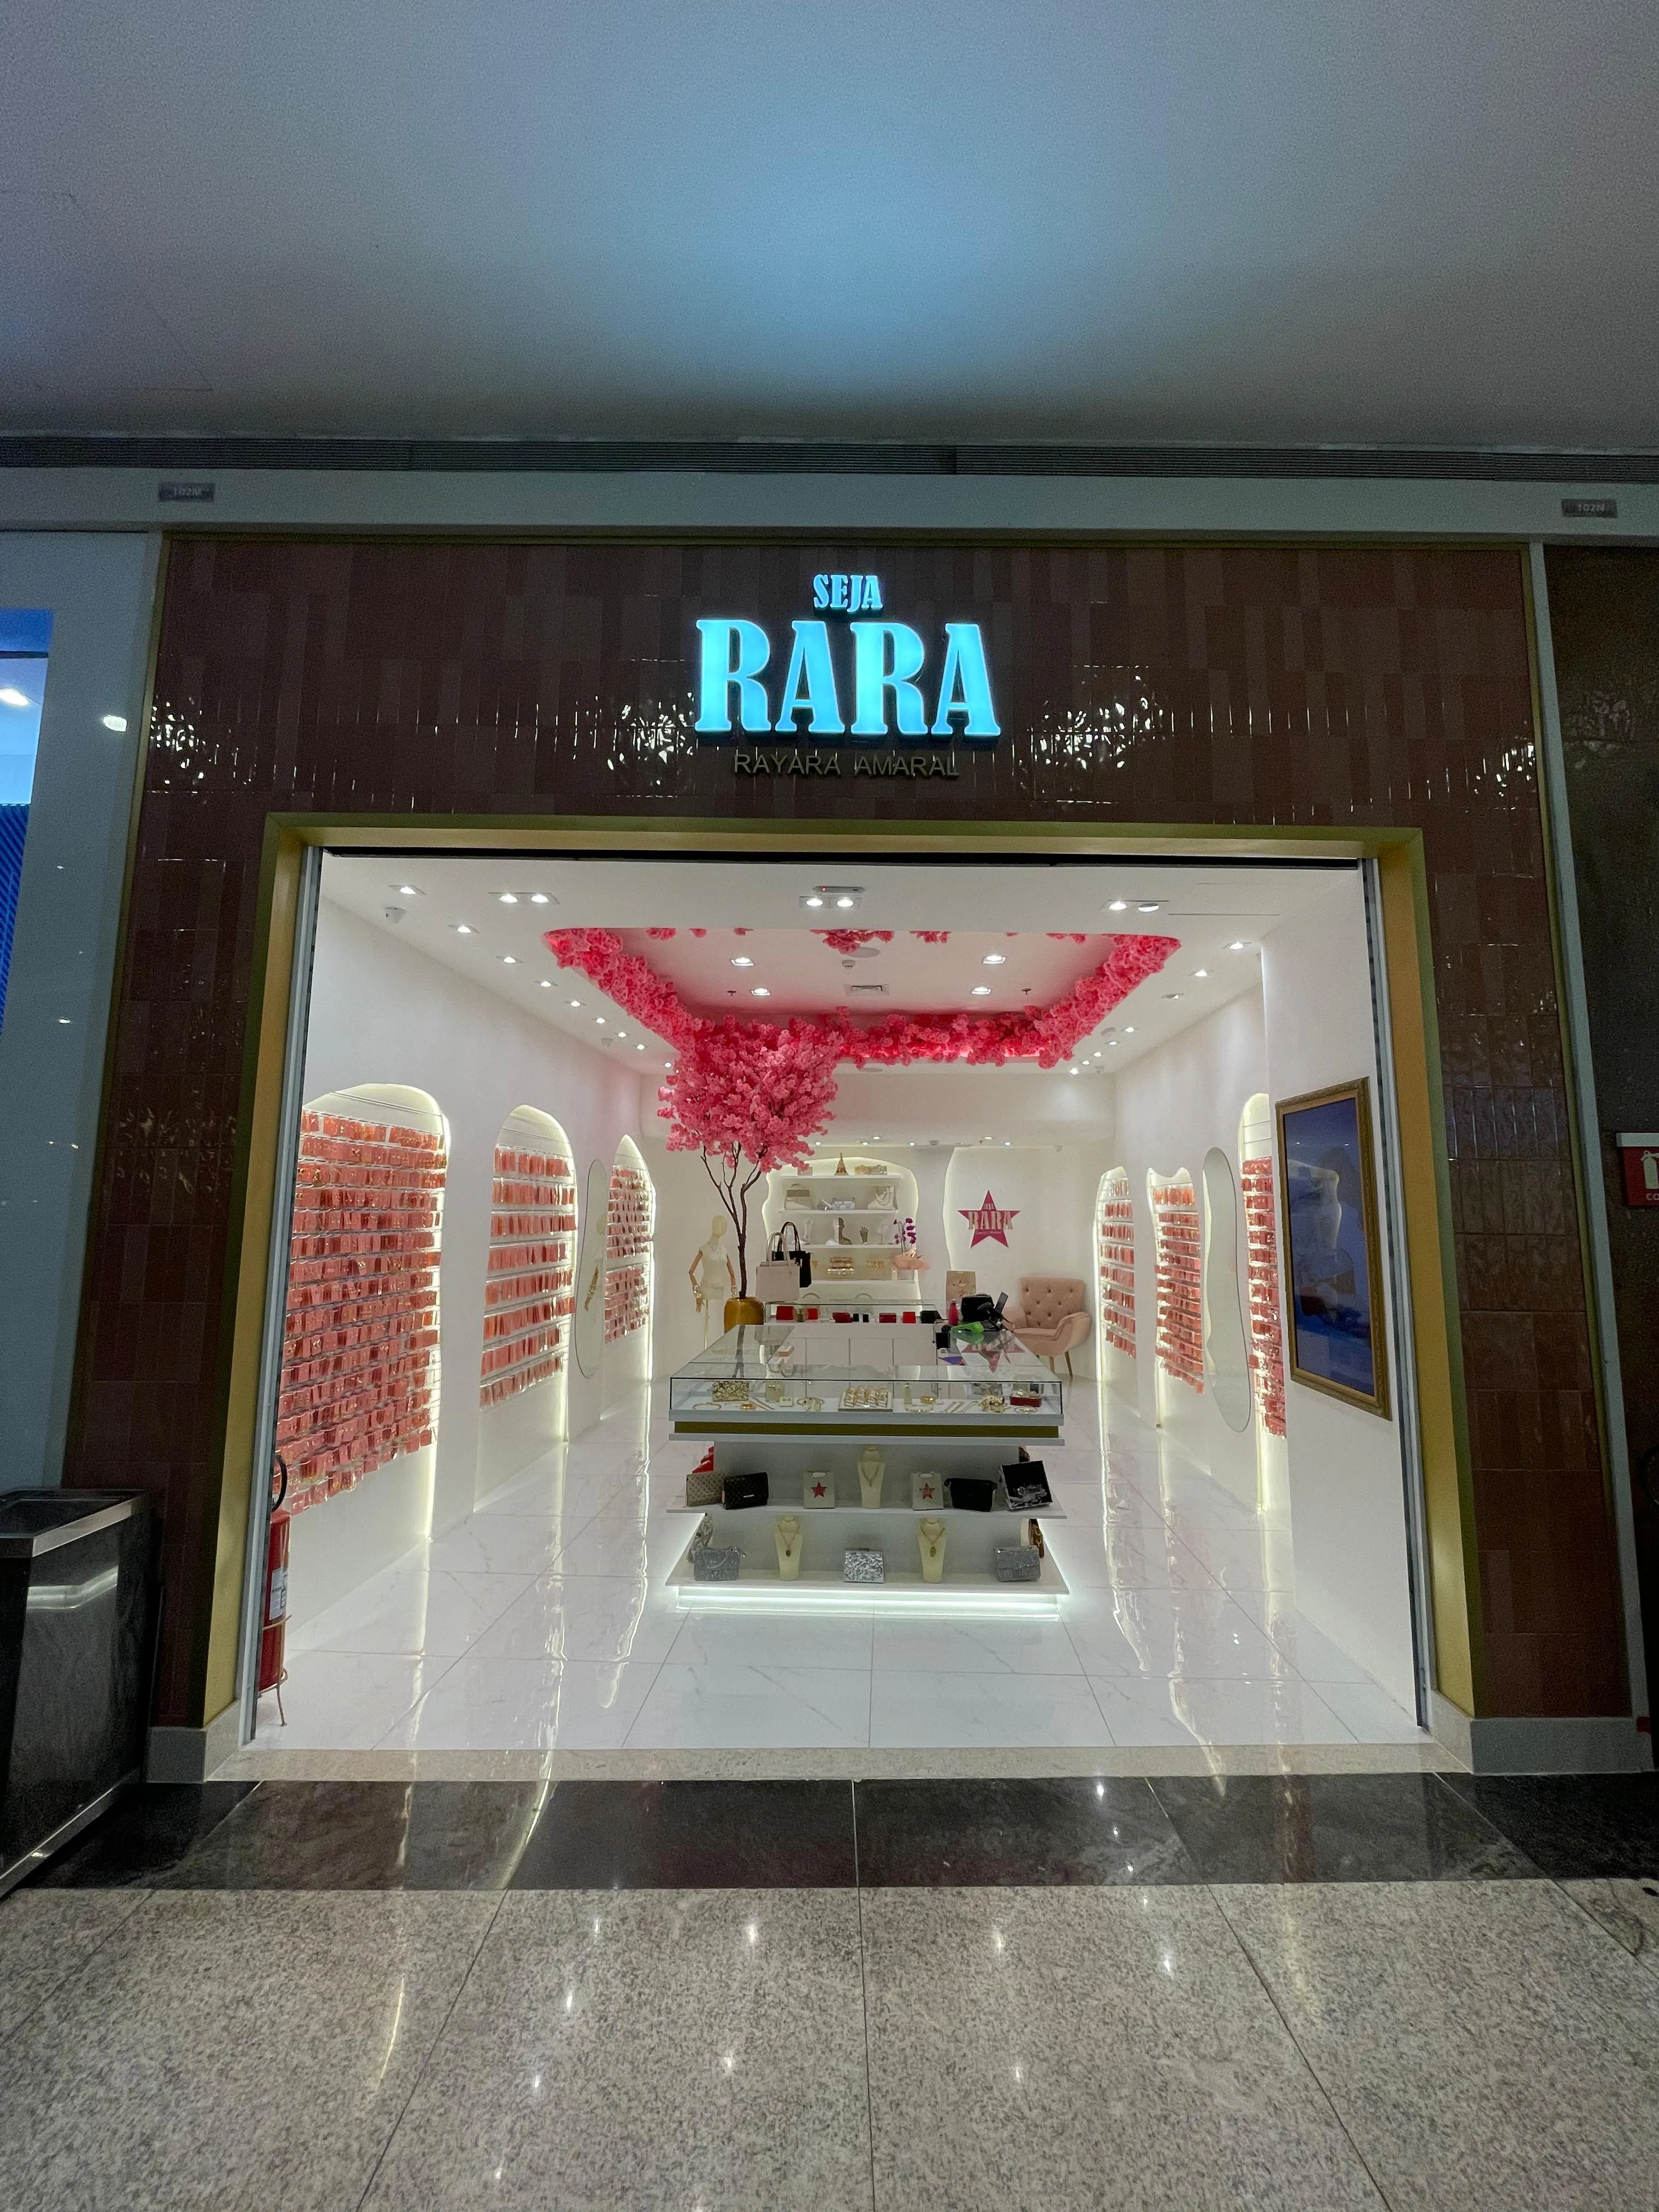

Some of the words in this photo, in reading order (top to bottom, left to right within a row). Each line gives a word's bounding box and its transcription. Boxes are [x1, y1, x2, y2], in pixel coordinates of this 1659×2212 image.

[813, 574, 883, 612] SEJA
[695, 619, 1001, 736] RARA
[734, 754, 841, 775] RAYARA
[854, 755, 960, 776] AMARAL
[968, 1210, 1013, 1229] RARA
